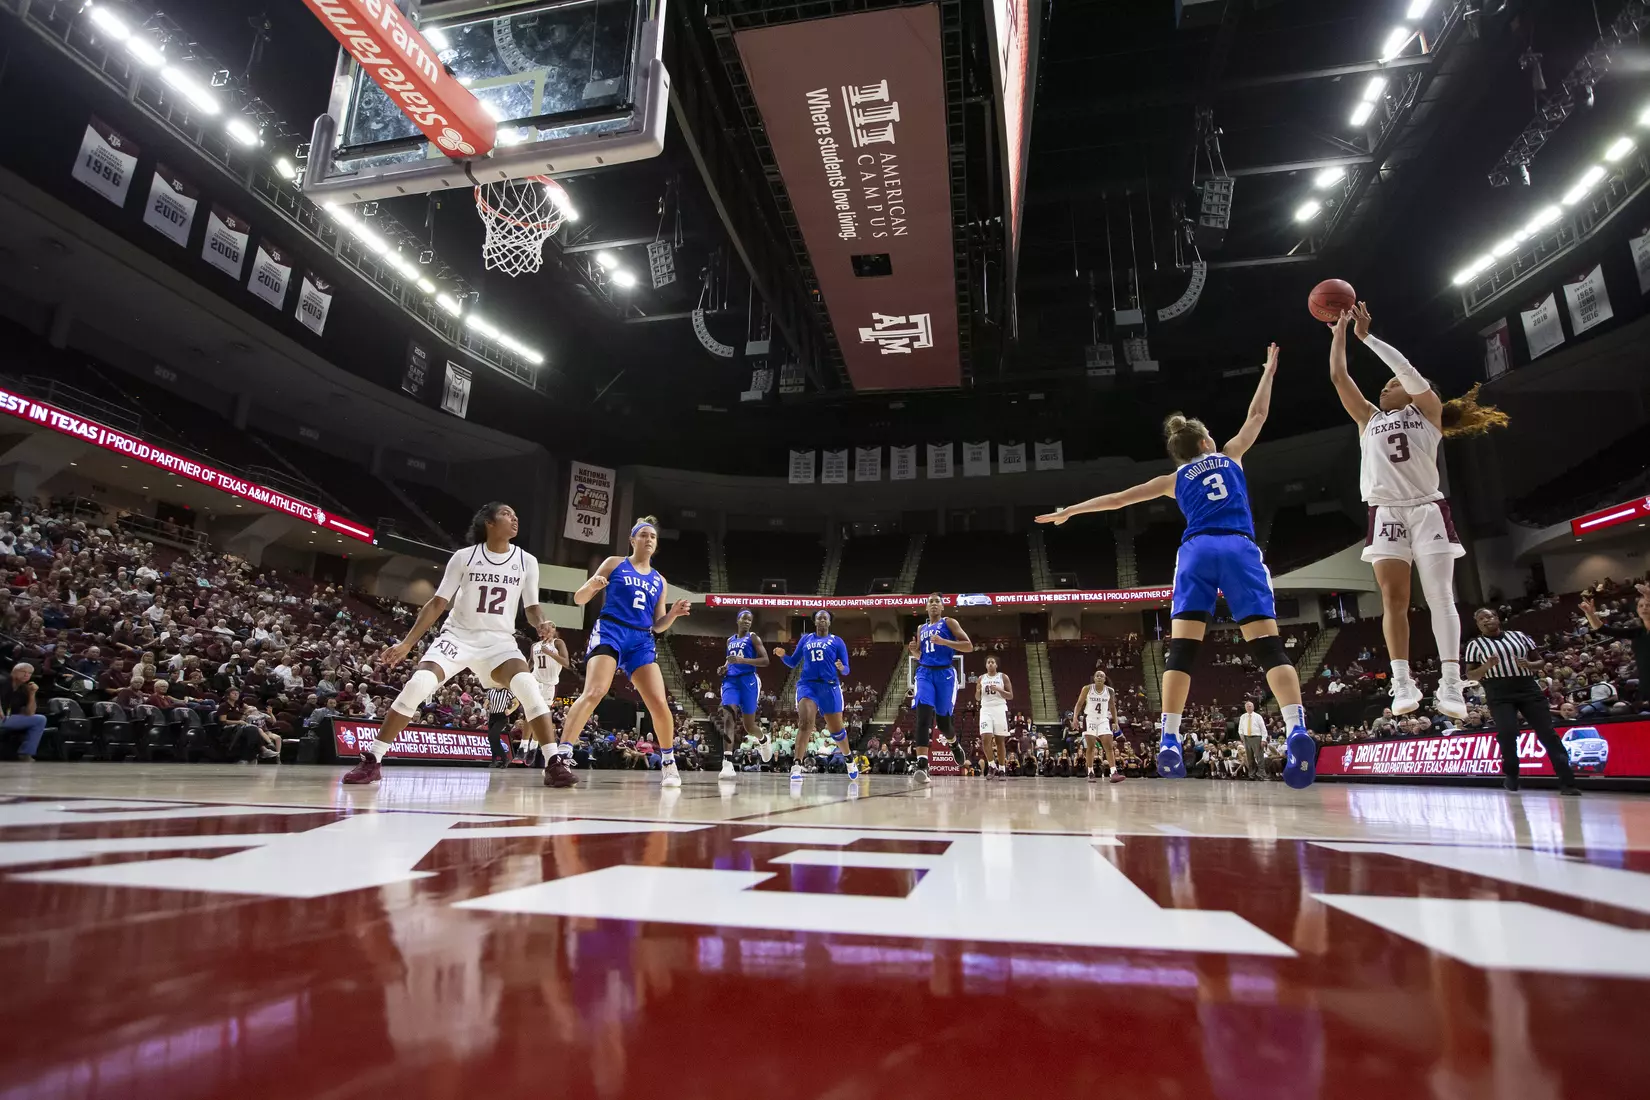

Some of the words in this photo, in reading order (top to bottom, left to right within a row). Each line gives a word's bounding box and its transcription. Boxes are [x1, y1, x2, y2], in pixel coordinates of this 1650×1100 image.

[805, 87, 832, 137] Where
[84, 154, 124, 187] 1996
[818, 136, 845, 188] students
[831, 187, 851, 212] love
[857, 153, 888, 239] CAMPUS
[880, 152, 908, 237] AMERICAN
[153, 199, 187, 228] 2007
[838, 210, 858, 240] living.
[210, 237, 241, 263] 2008
[257, 271, 283, 293] 2010
[301, 299, 324, 320] 2013
[1581, 310, 1599, 324] 2016
[1371, 420, 1401, 437] TEXAS
[1403, 420, 1424, 430] A&M
[1388, 432, 1410, 463] 3
[30, 404, 48, 422] IN
[50, 411, 98, 440] TEXAS
[106, 432, 150, 458] PROUD
[150, 449, 201, 477] PARTNER
[202, 469, 217, 481] OF
[217, 474, 248, 495] TEXAS
[248, 486, 269, 503] A&M
[270, 494, 313, 518] ATHLETICS
[1185, 459, 1229, 480] GOODCHILD
[574, 475, 610, 488] CHAMPIONS
[578, 468, 607, 480] NATIONAL
[1202, 473, 1229, 501] 3
[576, 513, 601, 527] 2011
[469, 572, 500, 583] TEXAS
[502, 574, 520, 586] A&M
[623, 576, 658, 597] DUKE
[476, 585, 508, 615] 12
[632, 590, 646, 610] 2
[722, 597, 742, 605] DRIVE
[764, 598, 777, 606] THE
[777, 598, 793, 606] BEST
[995, 595, 1016, 603] DRIVE
[1024, 594, 1039, 602] LIKE
[1107, 592, 1130, 600] PROUD
[1131, 590, 1161, 599] PARTNER
[1162, 590, 1171, 598] OF
[920, 629, 941, 641] DUKE
[728, 641, 747, 651] DUKE
[806, 641, 828, 650] DUKE
[810, 649, 824, 662] 13
[925, 640, 935, 653] 11
[537, 655, 547, 669] 11
[1095, 703, 1101, 714] 4
[399, 730, 419, 743] LIKE
[419, 731, 437, 744] THE
[437, 733, 457, 745] BEST
[458, 734, 467, 745] IN
[467, 735, 491, 747] TEXAS
[1354, 744, 1382, 762] DRIVE
[1380, 743, 1392, 761] IT
[1393, 741, 1416, 761] LIKE
[1415, 740, 1439, 760] THE
[1438, 737, 1475, 760] BEST
[1473, 735, 1493, 759] IN
[387, 742, 419, 753] ARTNER
[419, 744, 428, 754] OF
[428, 744, 449, 755] TEXAS
[465, 746, 492, 756] ATHLETICS
[1371, 762, 1389, 773] PROUD
[1389, 762, 1414, 773] PARTNER
[1414, 761, 1423, 773] OF
[1423, 761, 1443, 773] TEXAS
[1459, 759, 1502, 773] ATHLETICS
